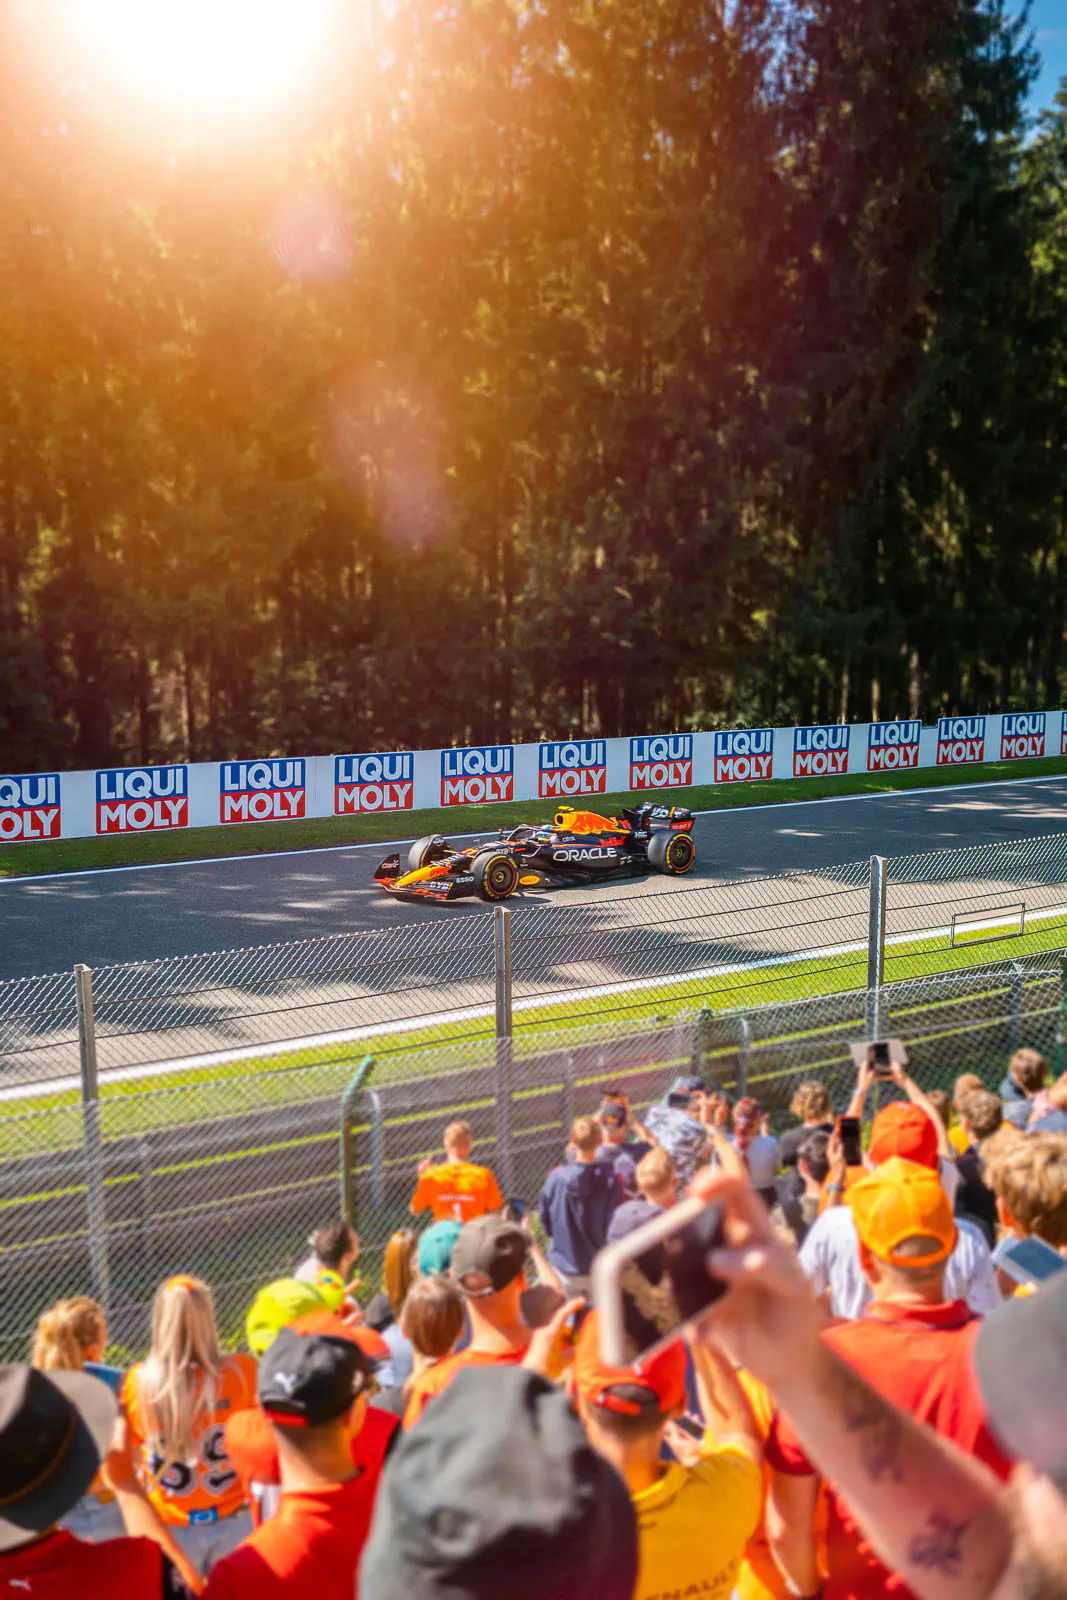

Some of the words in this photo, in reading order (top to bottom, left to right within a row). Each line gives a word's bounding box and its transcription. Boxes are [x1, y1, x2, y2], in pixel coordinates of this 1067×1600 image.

[870, 723, 918, 746] LIQUI
[940, 718, 984, 742] LIQUI
[1003, 714, 1044, 736] LIQUI
[632, 737, 690, 762] LIQUI
[717, 731, 771, 756] LIQUI
[796, 727, 848, 750] LIQUI
[1002, 736, 1044, 758] MOLY
[444, 749, 511, 776] LIQUI
[542, 743, 603, 769] LIQUI
[796, 751, 848, 775] MOLY
[869, 746, 918, 770] MOLY
[938, 741, 984, 764] MOLY
[224, 761, 301, 791] LIQUI
[338, 755, 410, 783] LIQUI
[632, 762, 691, 788] MOLY
[716, 756, 772, 781] MOLY
[0, 777, 56, 808] QUI
[100, 768, 184, 800] LIQUI
[444, 775, 512, 804] MOLY
[542, 769, 605, 796] MOLY
[224, 791, 304, 821] MOLY
[338, 783, 412, 812] MOLY
[0, 808, 59, 839] OLY
[100, 799, 187, 832] MOLY
[553, 847, 618, 862] ORACLE
